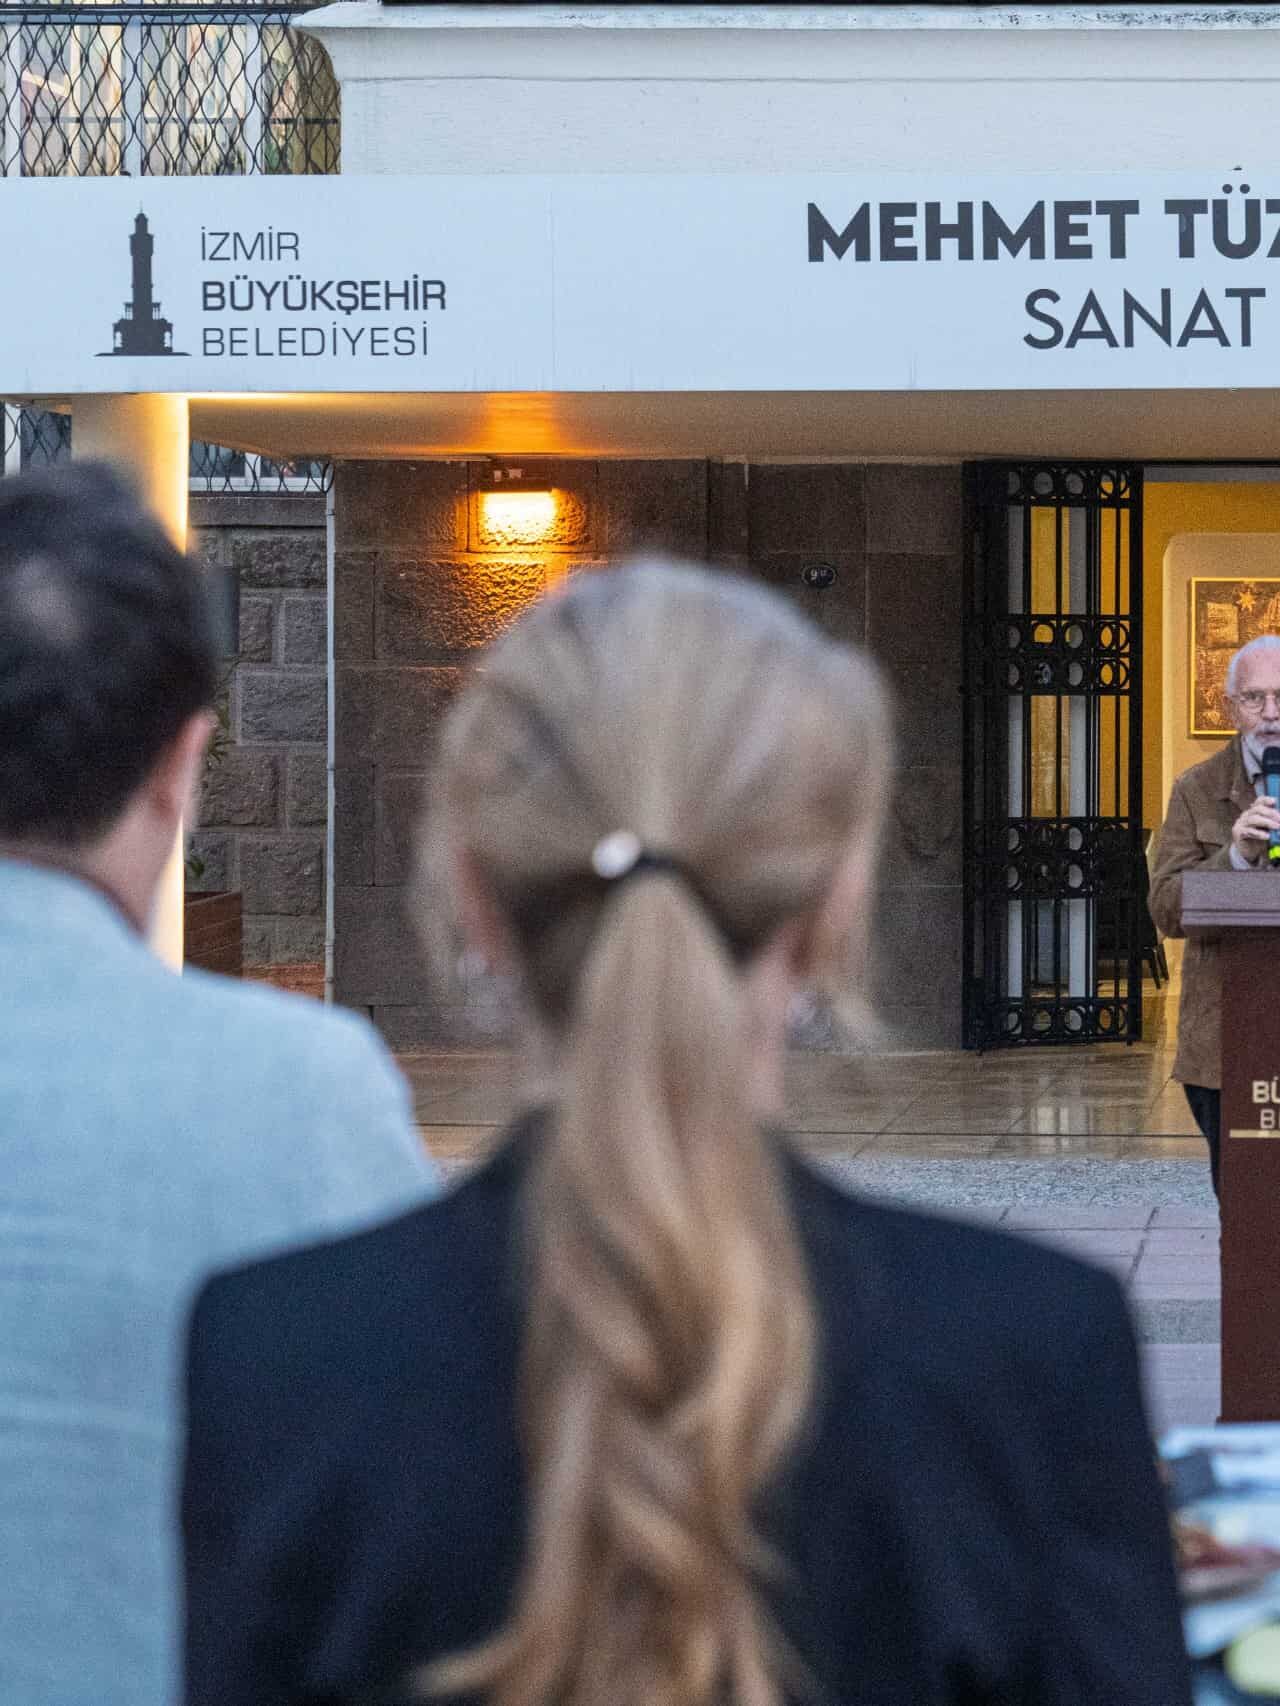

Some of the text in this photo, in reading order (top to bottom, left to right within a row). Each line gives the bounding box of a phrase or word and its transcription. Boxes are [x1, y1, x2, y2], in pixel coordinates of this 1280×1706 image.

[201, 226, 300, 261] İZMİR
[808, 200, 1139, 262] MEHMET
[202, 273, 446, 315] BÜYÜKŞEHİR
[202, 321, 428, 357] BELEDİYESİ
[1023, 287, 1266, 350] SANAT
